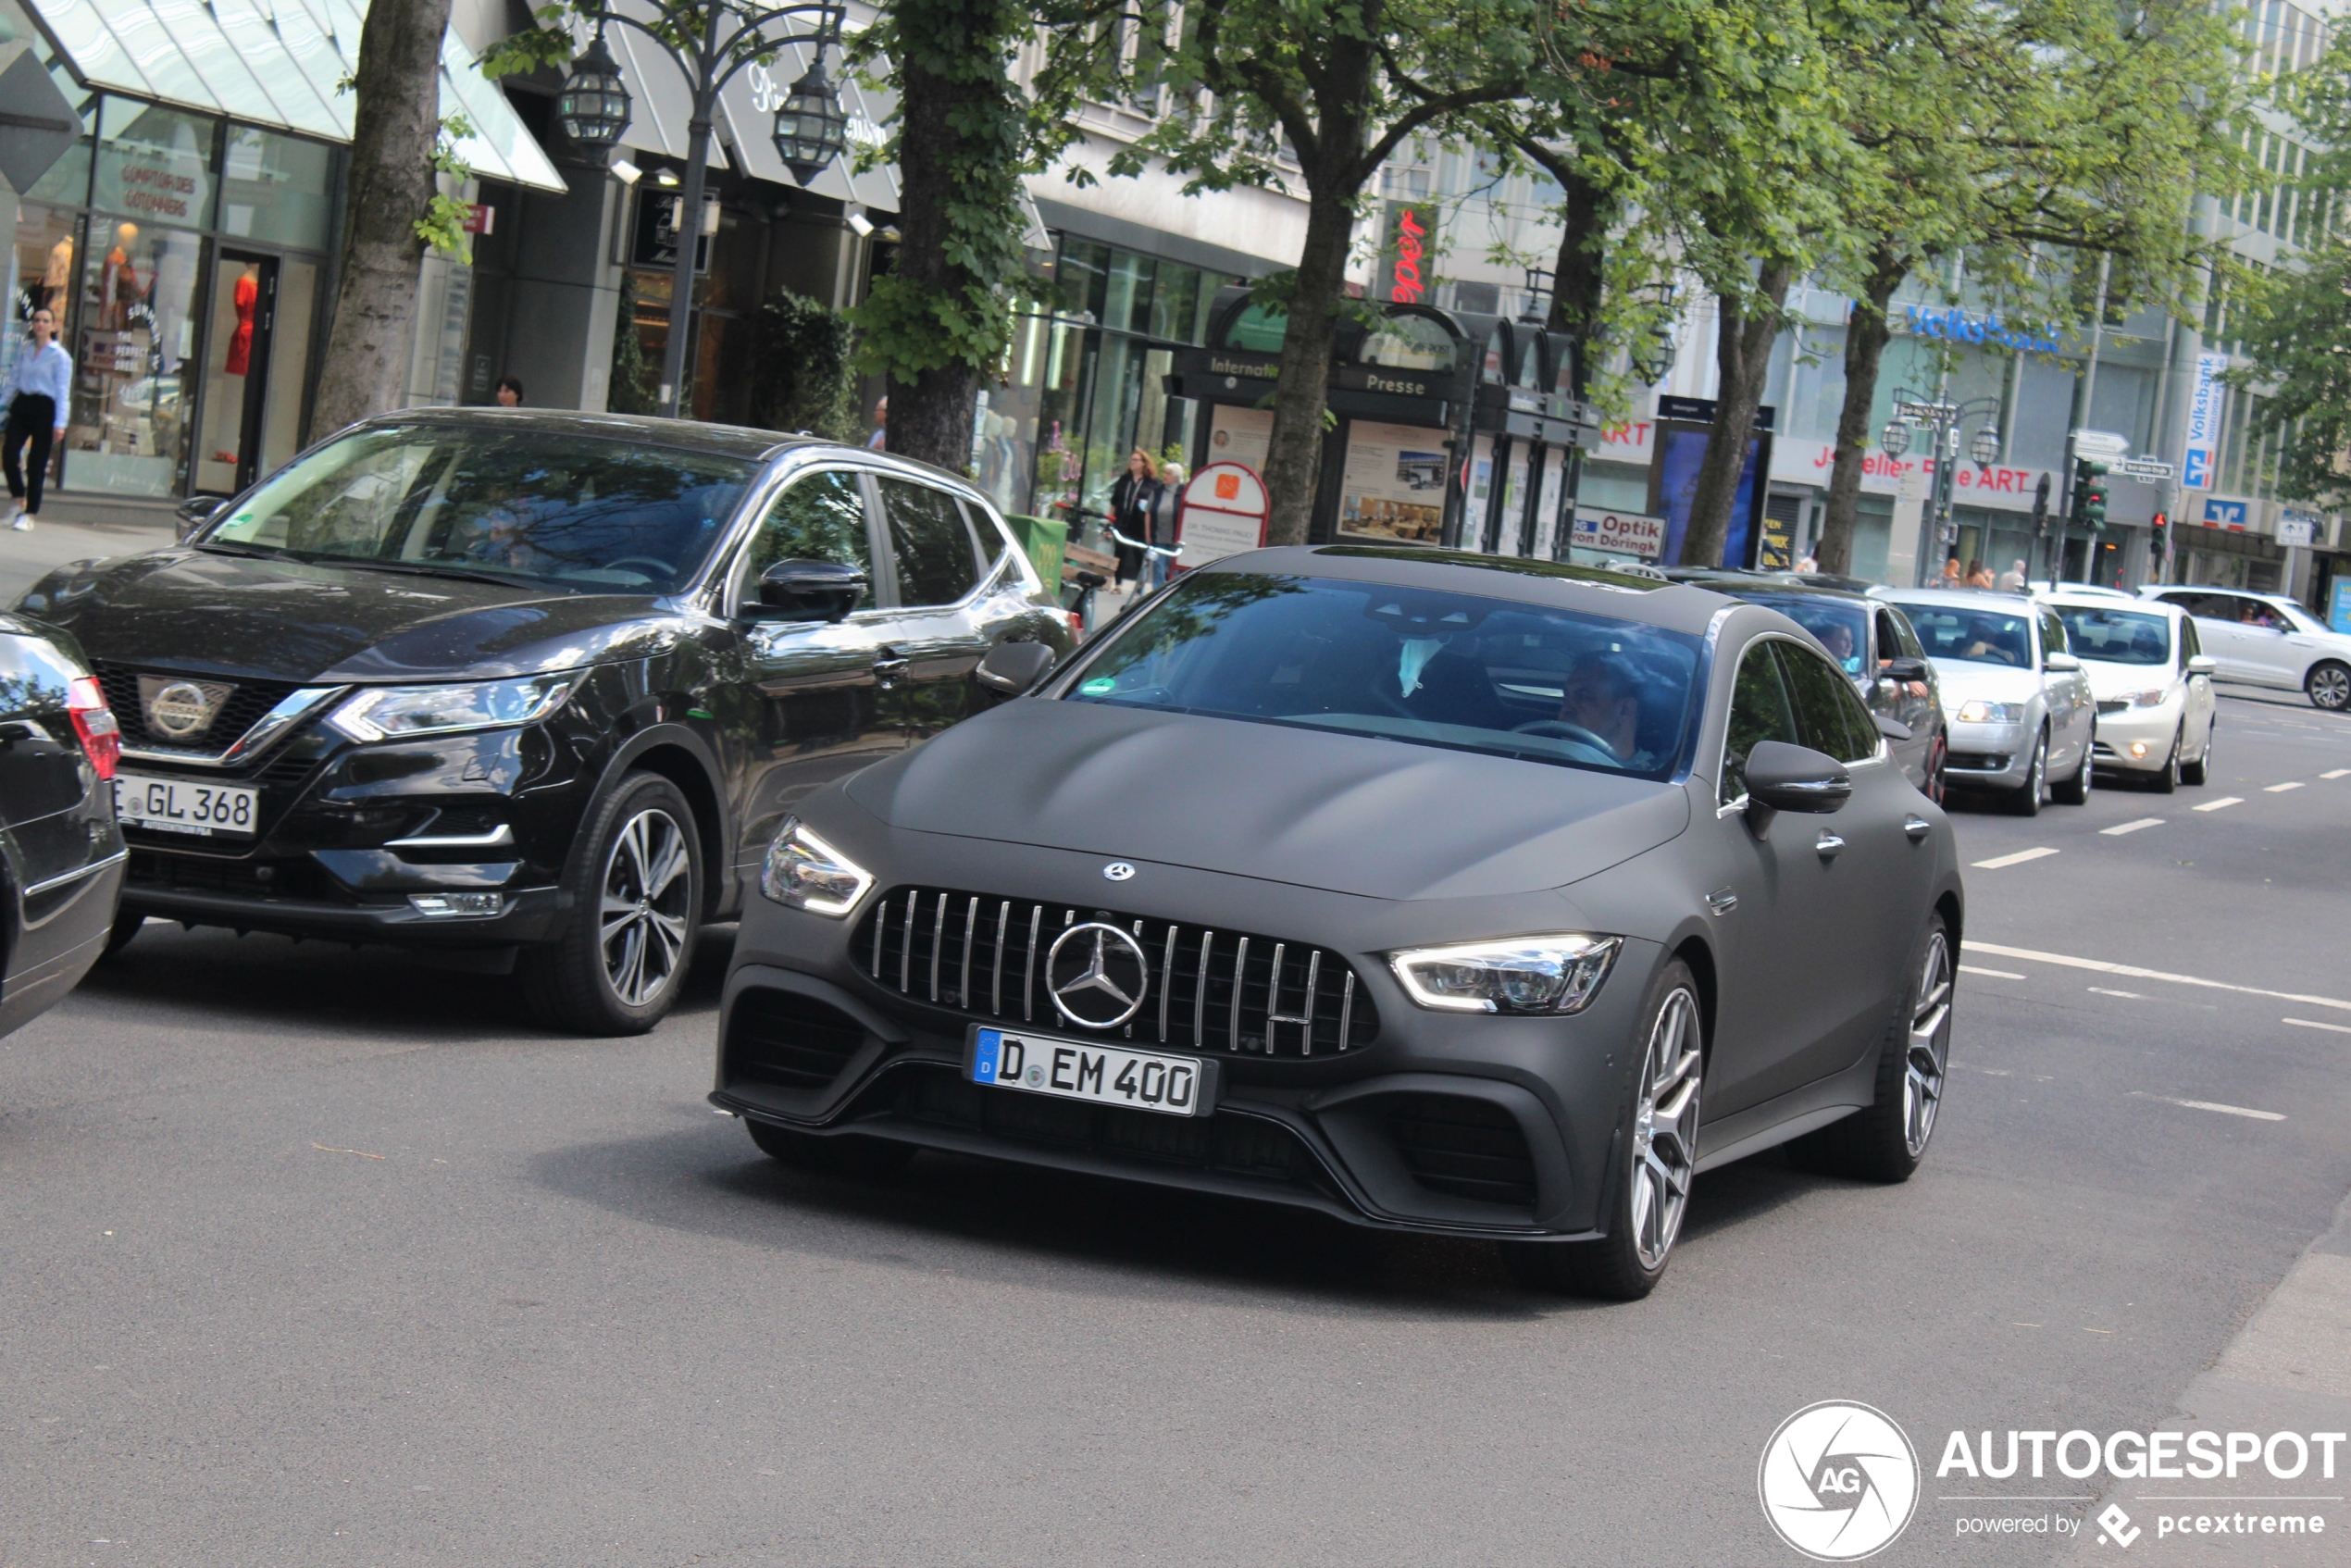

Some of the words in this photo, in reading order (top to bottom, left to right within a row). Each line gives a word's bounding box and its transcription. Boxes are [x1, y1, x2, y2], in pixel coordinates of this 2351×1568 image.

[1211, 357, 1277, 378] Internat
[1367, 374, 1425, 395] Presse
[2189, 358, 2214, 441] Volksbank
[1976, 467, 2031, 494] ART
[1603, 516, 1660, 538] Optik
[1599, 534, 1656, 554] Döringk
[147, 783, 184, 818] GL
[193, 788, 250, 826] 368
[980, 1062, 991, 1075] D
[999, 1039, 1026, 1080] D
[1050, 1047, 1106, 1095] EM
[1113, 1058, 1194, 1108] 400
